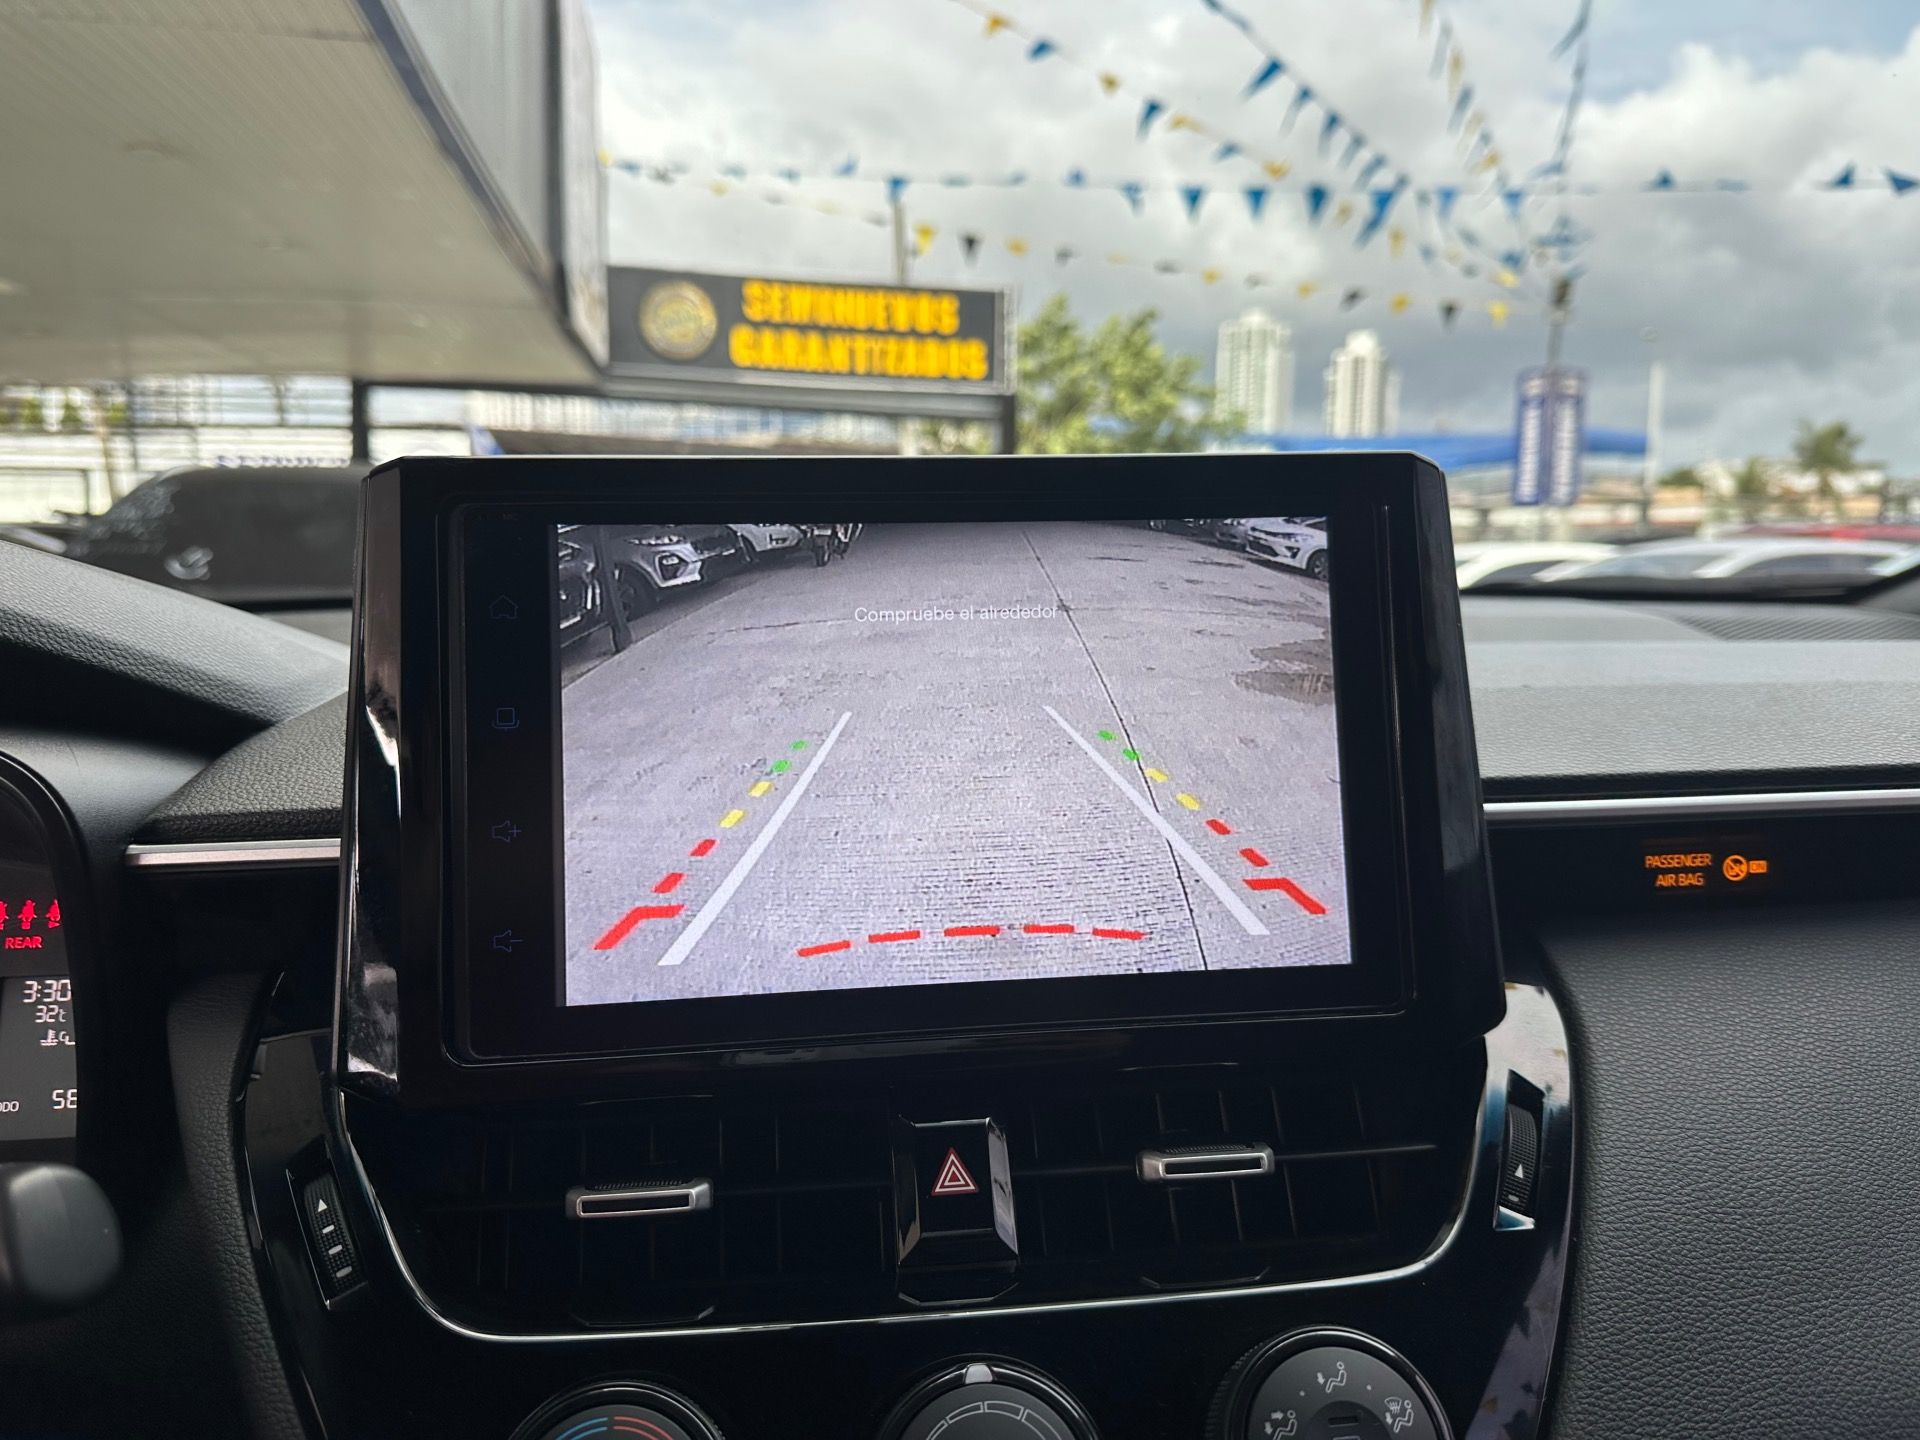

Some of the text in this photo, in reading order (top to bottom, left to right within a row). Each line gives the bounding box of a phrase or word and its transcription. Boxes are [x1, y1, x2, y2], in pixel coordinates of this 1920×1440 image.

[854, 604, 1058, 625] Compruebe el alrededor
[1645, 853, 1712, 868] PASSENGER
[1655, 873, 1704, 887] AIR BAG
[5, 936, 42, 949] REAR
[23, 979, 71, 1003] 3:30
[0, 1101, 20, 1112] DO
